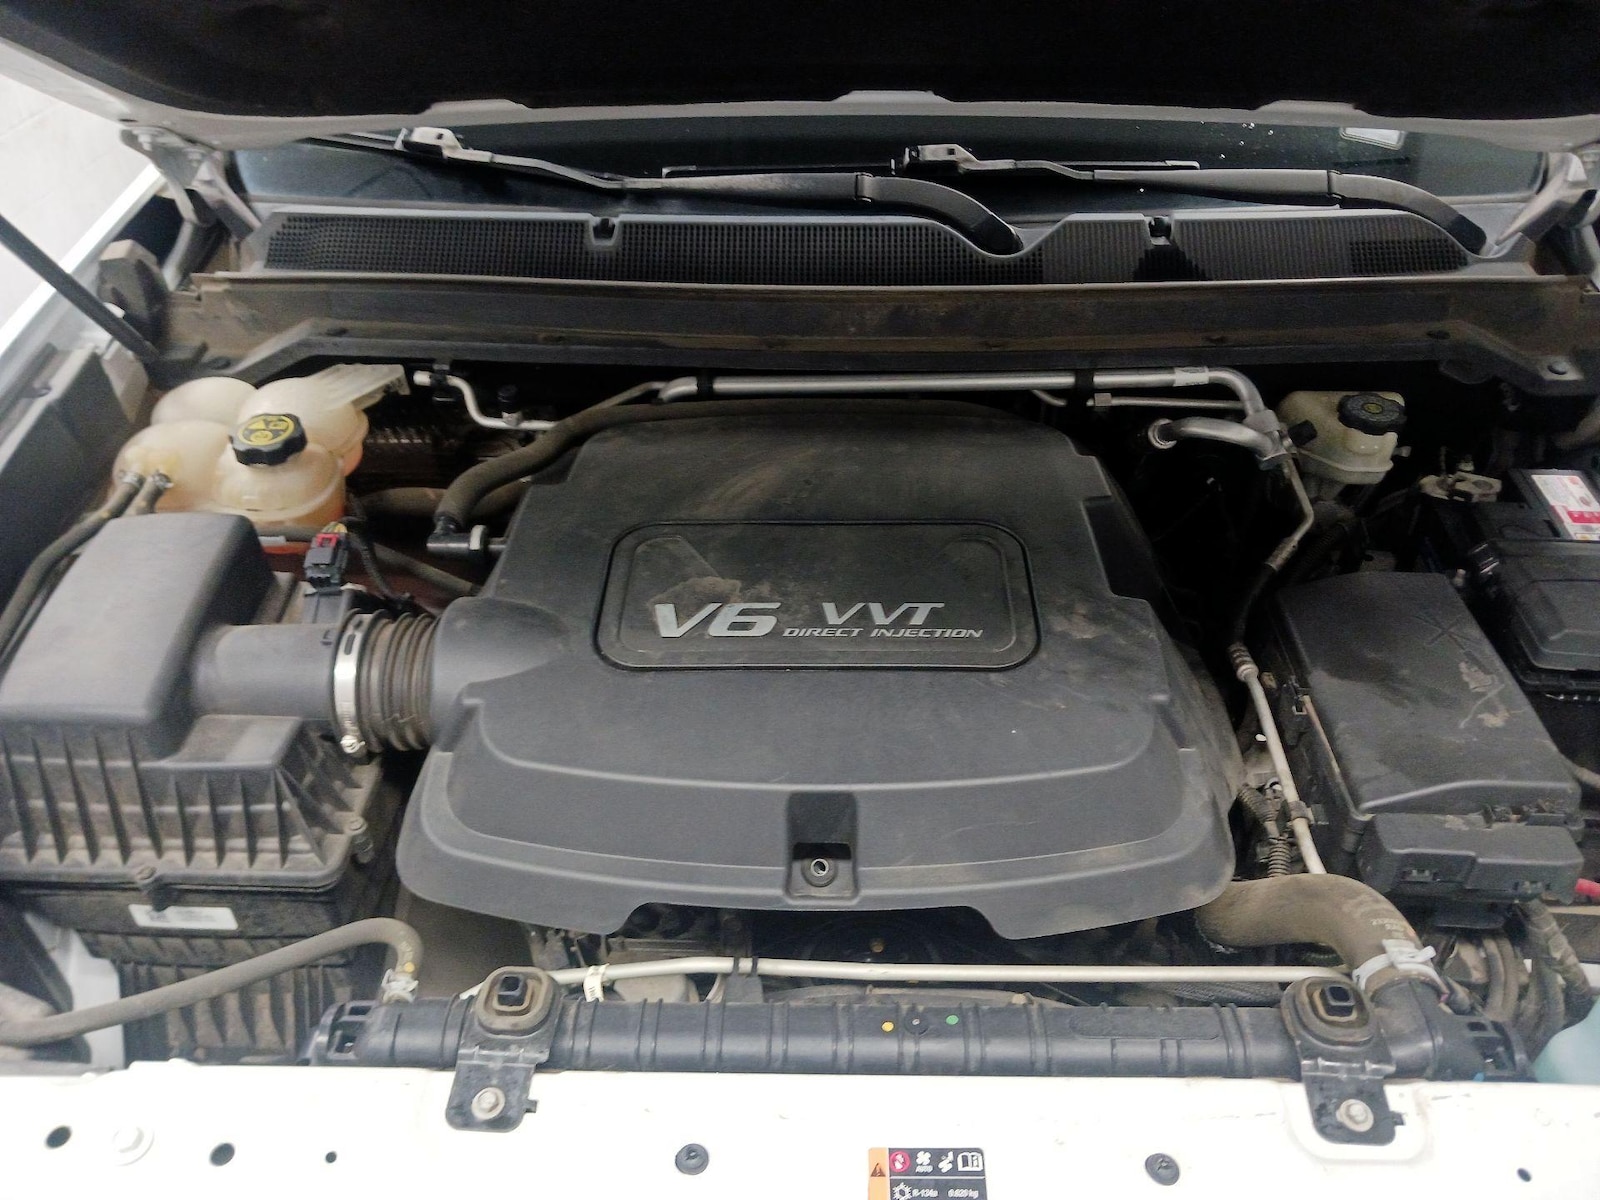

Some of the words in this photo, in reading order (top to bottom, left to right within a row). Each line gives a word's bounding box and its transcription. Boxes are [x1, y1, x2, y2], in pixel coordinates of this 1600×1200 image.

[653, 602, 782, 638] V6
[821, 602, 946, 626] VVT
[781, 627, 864, 639] DIRECT
[869, 627, 984, 639] INJECTION
